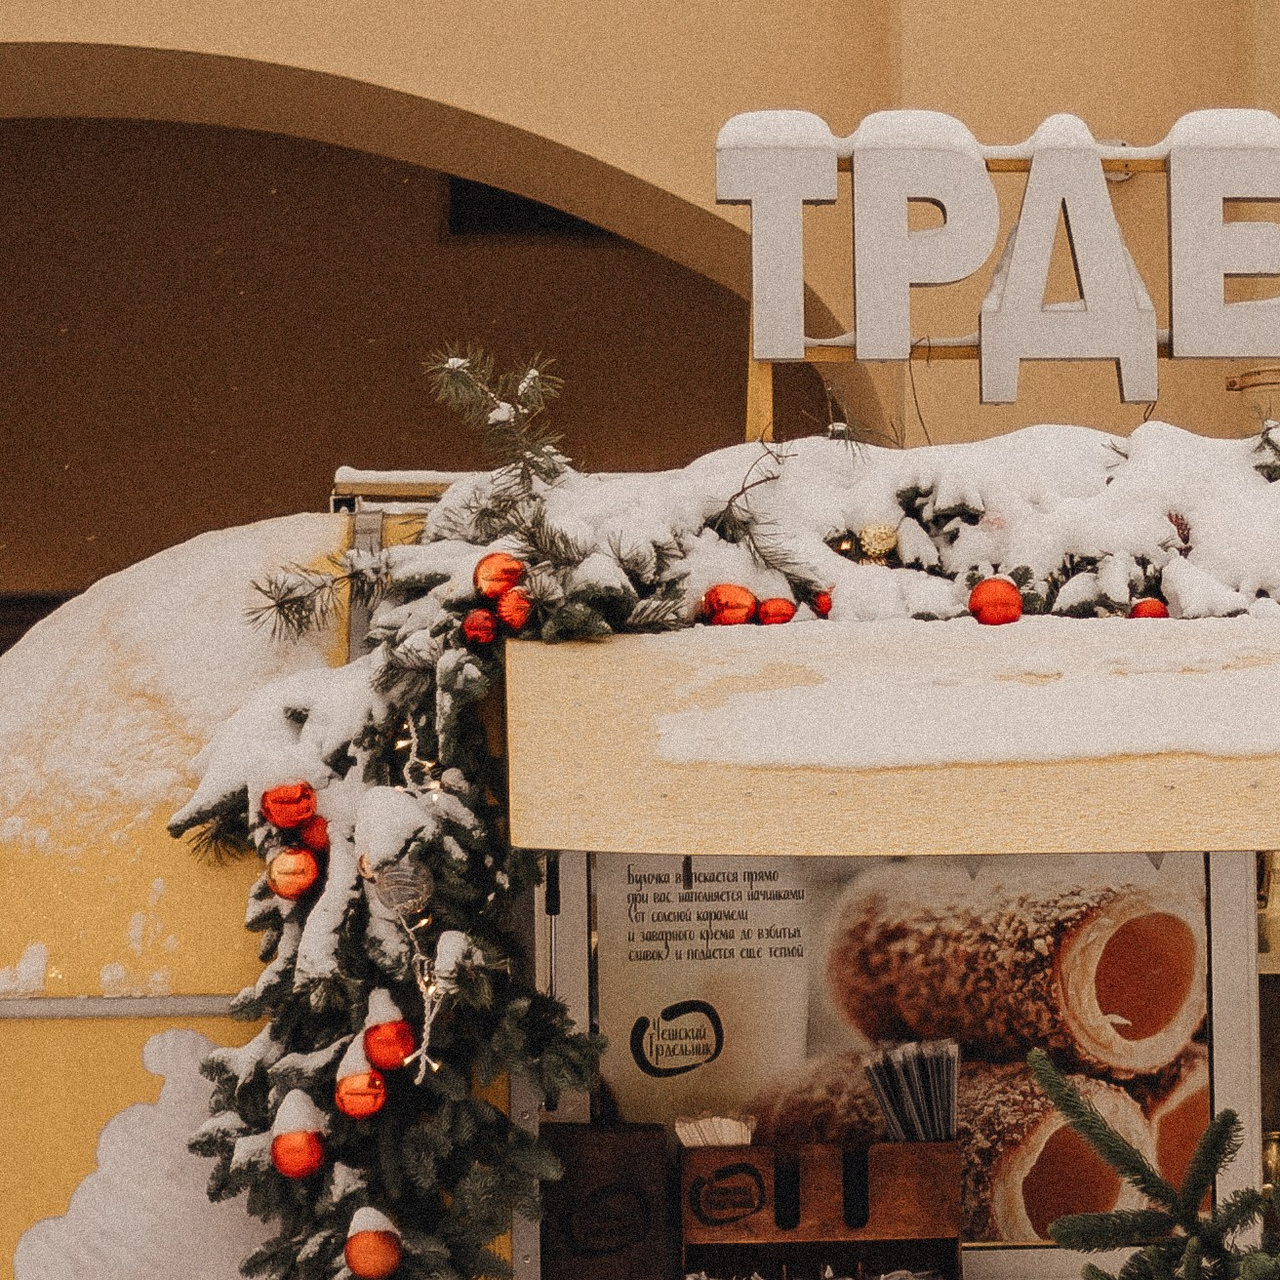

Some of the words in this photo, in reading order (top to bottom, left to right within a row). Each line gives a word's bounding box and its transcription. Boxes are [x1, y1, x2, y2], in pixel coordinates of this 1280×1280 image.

[627, 863, 670, 891] Булочка
[675, 870, 739, 885] впекается
[743, 870, 780, 891] прямо
[627, 891, 648, 912] при
[678, 889, 743, 904] наполняется
[747, 888, 805, 902] начинками
[628, 902, 646, 924] (от
[651, 908, 693, 923] соленой
[696, 909, 749, 929] карамели
[628, 931, 636, 943] и
[640, 927, 696, 949] заварного
[699, 927, 736, 949] крема
[740, 928, 753, 940] до
[757, 923, 802, 939] взбитых
[628, 942, 670, 962] сливок)
[675, 948, 682, 960] и
[686, 946, 736, 961] подается
[740, 946, 763, 959] еще
[768, 943, 804, 959] теплой
[653, 1016, 707, 1041] Чешский
[648, 1032, 714, 1065] Трдельник
